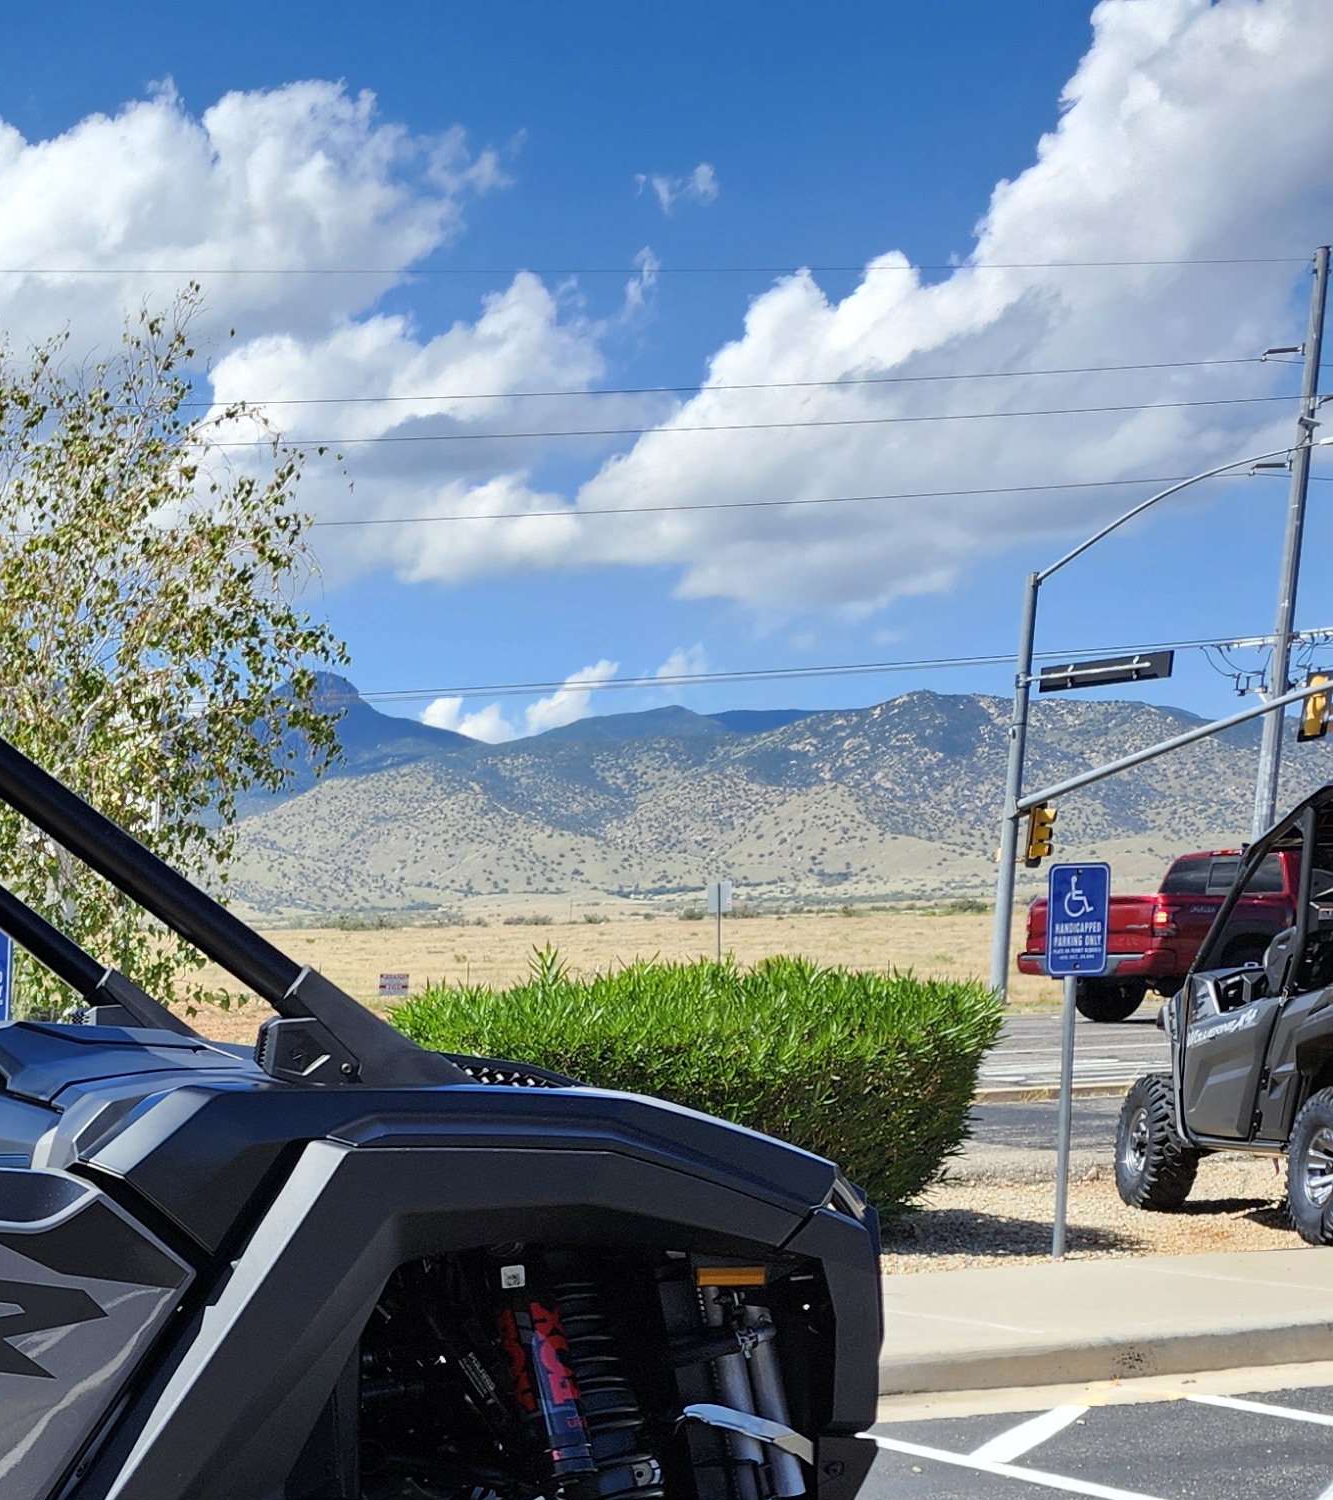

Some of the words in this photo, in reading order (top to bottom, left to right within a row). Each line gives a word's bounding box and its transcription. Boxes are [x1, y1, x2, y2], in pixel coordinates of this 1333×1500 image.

[1055, 922, 1102, 934] HANDICAPPED
[1053, 935, 1083, 947] PARKING
[1085, 934, 1102, 946] ONLY
